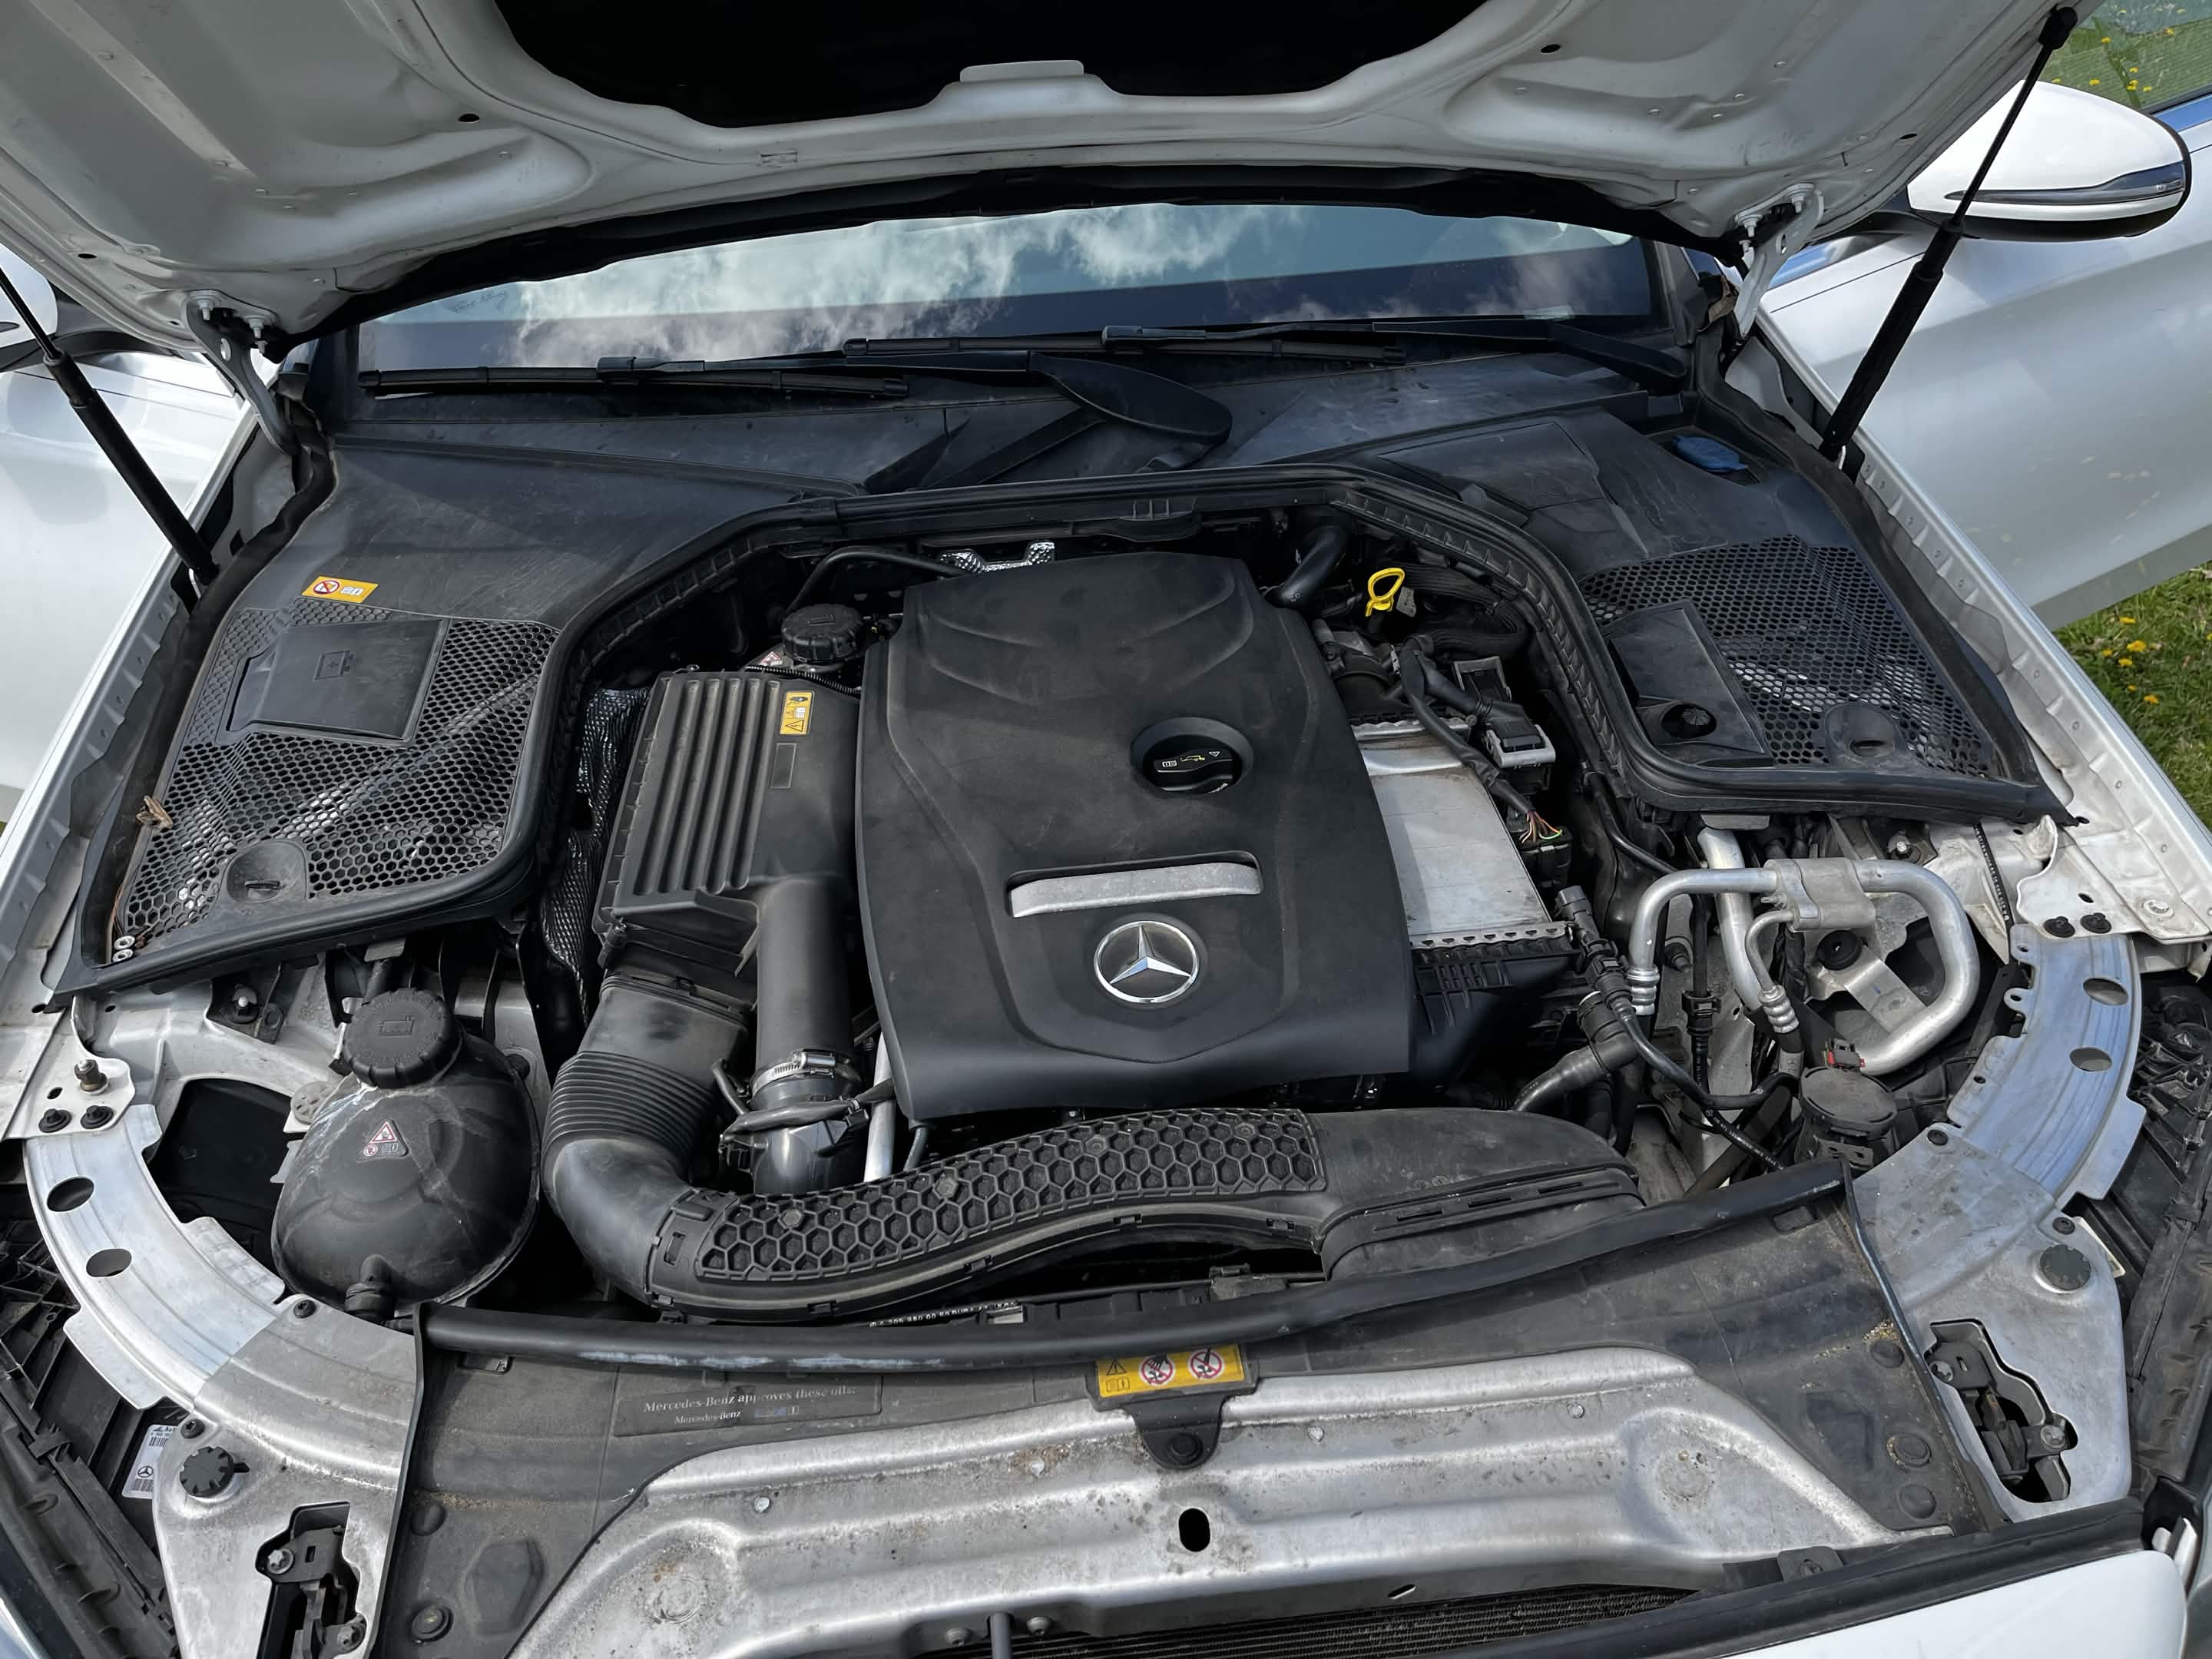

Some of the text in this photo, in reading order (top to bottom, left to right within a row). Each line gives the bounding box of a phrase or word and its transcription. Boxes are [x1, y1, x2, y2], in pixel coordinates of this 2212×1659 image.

[643, 1393, 736, 1413] Mercedes-Benz
[796, 1388, 827, 1399] these
[674, 1410, 743, 1426] Mercedes-Benz
